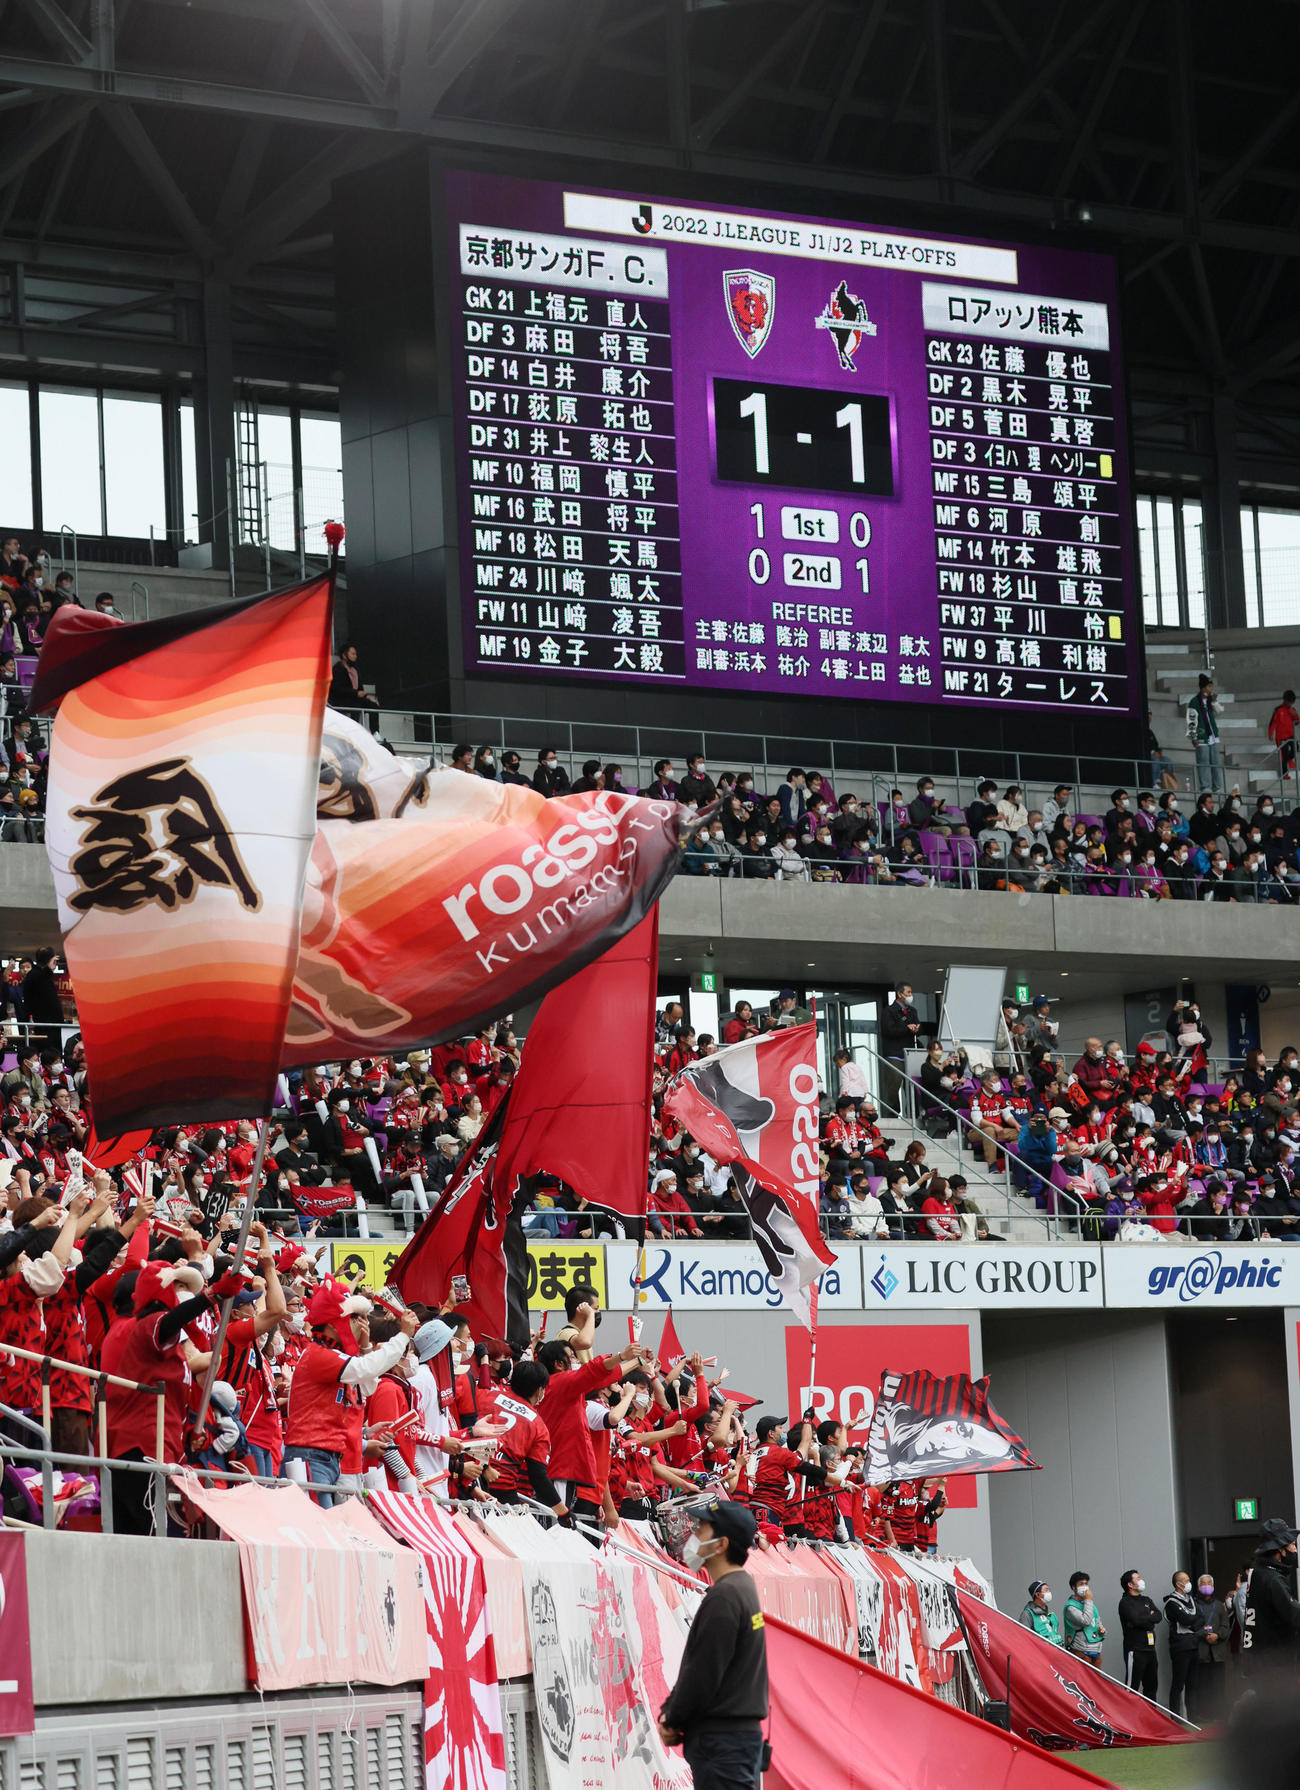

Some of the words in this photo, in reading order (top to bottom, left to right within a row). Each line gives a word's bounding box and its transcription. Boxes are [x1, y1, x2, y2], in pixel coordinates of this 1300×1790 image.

[663, 214, 708, 235] 2022
[713, 220, 800, 247] J.LEAGUE
[809, 232, 853, 254] J1/J2
[861, 240, 957, 267] PLAY-OFFS
[466, 286, 492, 309] GK
[498, 291, 514, 311] 21
[524, 291, 589, 322] 上福元
[606, 300, 648, 329] 直人
[948, 297, 1084, 337] ロアッソ熊本
[467, 321, 493, 343] DF
[502, 325, 515, 346] 3
[525, 324, 574, 355] 麻田
[600, 332, 649, 364] 将吾
[928, 341, 952, 362] GK
[957, 344, 973, 364] 23
[980, 343, 1025, 373] 佐藤
[1046, 351, 1091, 381] 優也
[468, 356, 495, 378] DF
[501, 359, 518, 380] 14
[528, 359, 576, 390] 白井
[602, 367, 651, 398] 康介
[930, 373, 953, 394] DF
[961, 377, 973, 397] 2
[982, 376, 1028, 405] 黒木
[470, 390, 496, 412] DF
[503, 394, 519, 415] 17
[528, 393, 578, 423] 荻原
[603, 400, 652, 431] 拓也
[932, 406, 955, 427] DF
[962, 409, 974, 430] 5
[984, 408, 1028, 437] 菅田
[471, 425, 498, 446] DF
[504, 428, 520, 449] 31
[530, 428, 572, 457] 井上
[739, 392, 770, 474] 1
[836, 403, 866, 483] 1
[473, 460, 499, 481] MF
[505, 463, 523, 484] 10
[531, 462, 580, 493] 福岡
[933, 439, 957, 460] DF
[964, 442, 976, 463] 3
[1028, 446, 1041, 472] 理
[1051, 452, 1097, 477] ヘンリー
[935, 472, 958, 493] MF
[964, 475, 980, 495] 15
[987, 476, 1032, 504] 三島
[474, 495, 500, 516] MF
[507, 498, 524, 519] 16
[532, 497, 581, 526] 武田
[607, 503, 656, 533] 将平
[750, 503, 765, 539] 1
[793, 513, 825, 537] 1st
[849, 512, 871, 548] 0
[936, 505, 960, 525] MF
[967, 508, 979, 528] 6
[989, 508, 1041, 537] 河原
[1080, 515, 1099, 543] 創
[475, 530, 502, 551] MF
[508, 532, 526, 554] 18
[533, 531, 583, 561] 松田
[608, 539, 658, 569] 天馬
[938, 538, 962, 558] MF
[968, 541, 983, 561] 14
[991, 539, 1036, 569] 竹本
[1057, 546, 1102, 575] 雄飛
[477, 565, 503, 587] MF
[509, 568, 527, 589] 24
[748, 548, 771, 585] 0
[792, 559, 831, 583] 2nd
[856, 558, 869, 594] 1
[940, 571, 963, 592] FW
[969, 574, 985, 594] 18
[992, 572, 1037, 601] 杉山
[1059, 579, 1103, 608] 直宏
[478, 600, 505, 622] FW
[511, 602, 527, 623] 11
[772, 603, 853, 625] REFEREE
[941, 604, 965, 624] FW
[970, 607, 986, 627] 37
[994, 606, 1046, 635] 平川
[480, 635, 506, 657] MF
[513, 637, 530, 658] 19
[538, 636, 589, 666] 金子
[943, 638, 967, 658] FW
[974, 640, 986, 660] 9
[1062, 645, 1107, 673] 利樹
[945, 670, 968, 692] MF
[974, 673, 988, 693] 21
[998, 672, 1109, 703] ターレス
[442, 791, 639, 942] roasso
[314, 1197, 351, 1205] roasso
[680, 1260, 841, 1307] Kamoga
[906, 1260, 966, 1294] LIC
[975, 1260, 1097, 1294] GROUP
